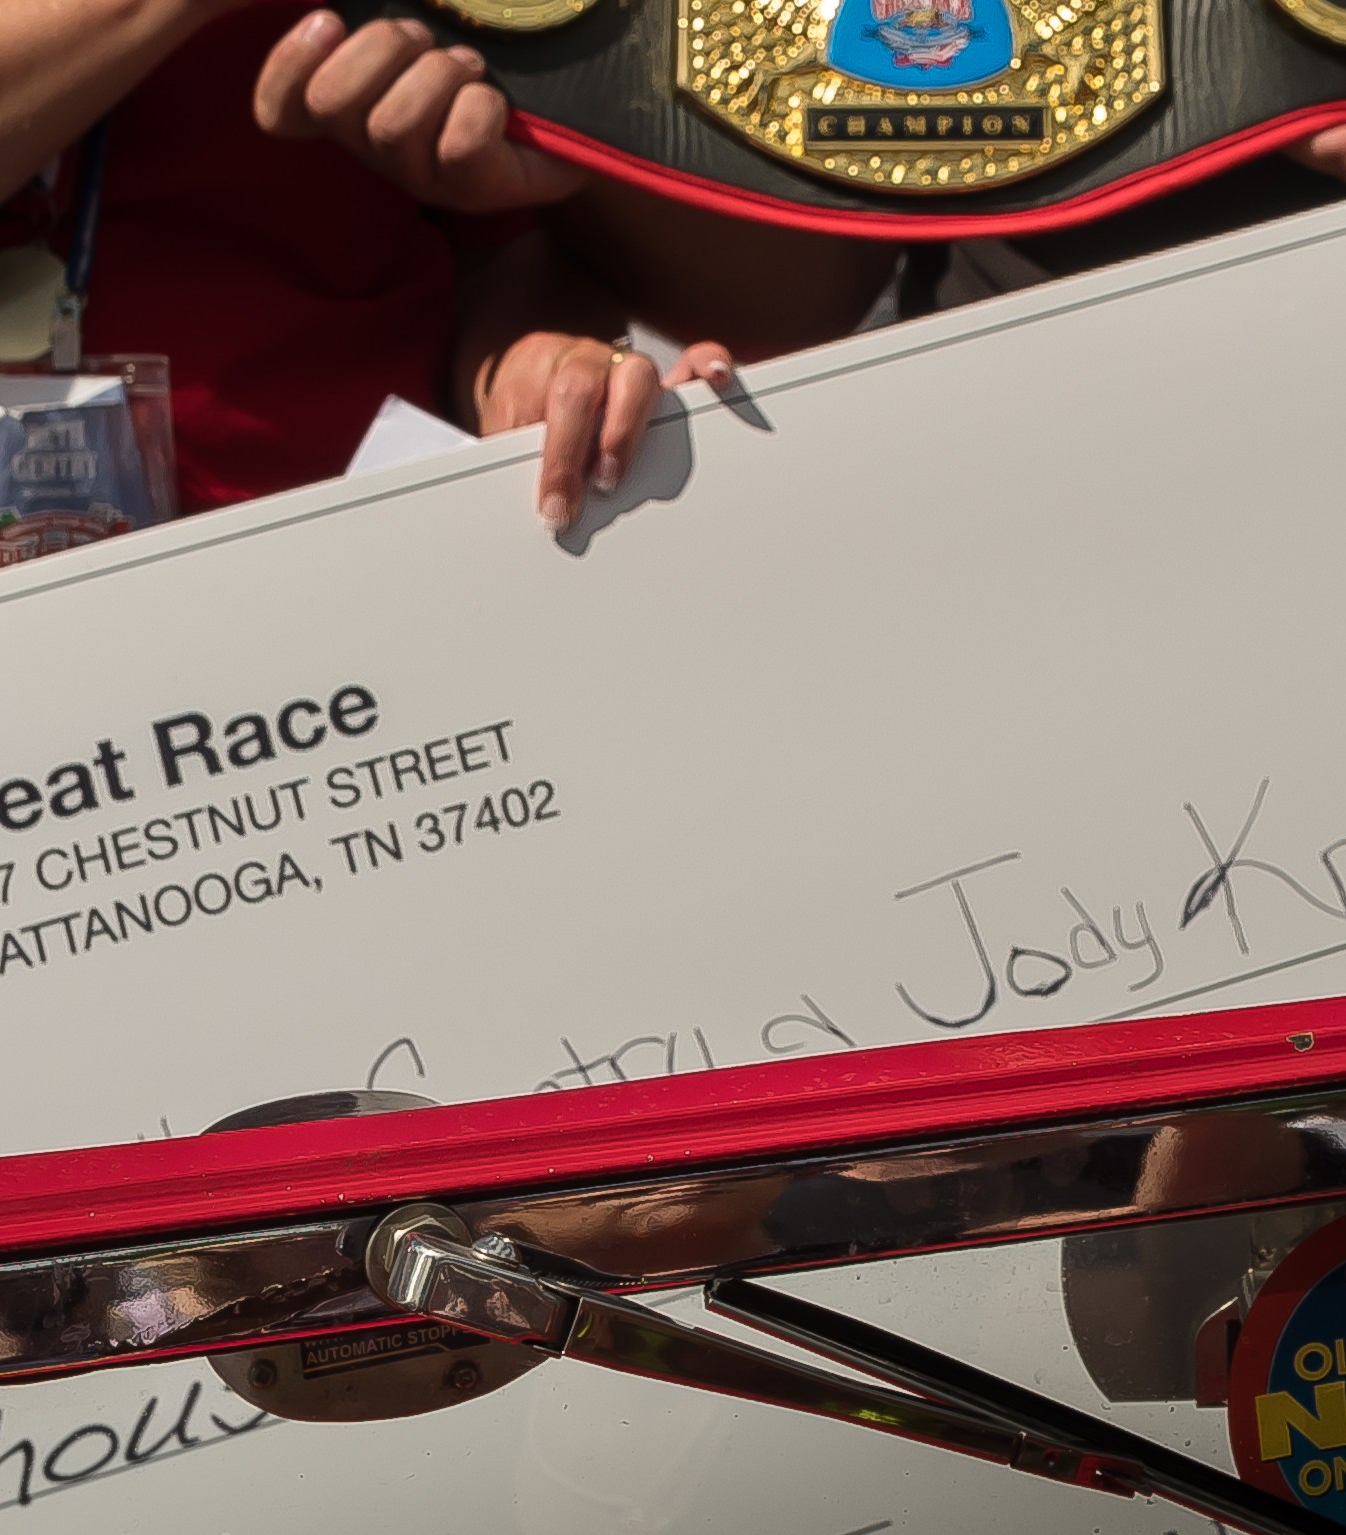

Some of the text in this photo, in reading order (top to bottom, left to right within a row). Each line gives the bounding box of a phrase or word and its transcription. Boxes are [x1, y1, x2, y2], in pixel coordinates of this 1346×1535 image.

[817, 114, 1031, 137] CHAMPION
[152, 684, 379, 791] Race
[36, 778, 316, 893] CHESTNUT
[325, 719, 516, 813] STREET
[329, 817, 401, 872] TN
[417, 778, 561, 851] 37402
[894, 851, 1167, 1030] Jody
[306, 1333, 402, 1366] AUTOMATIC
